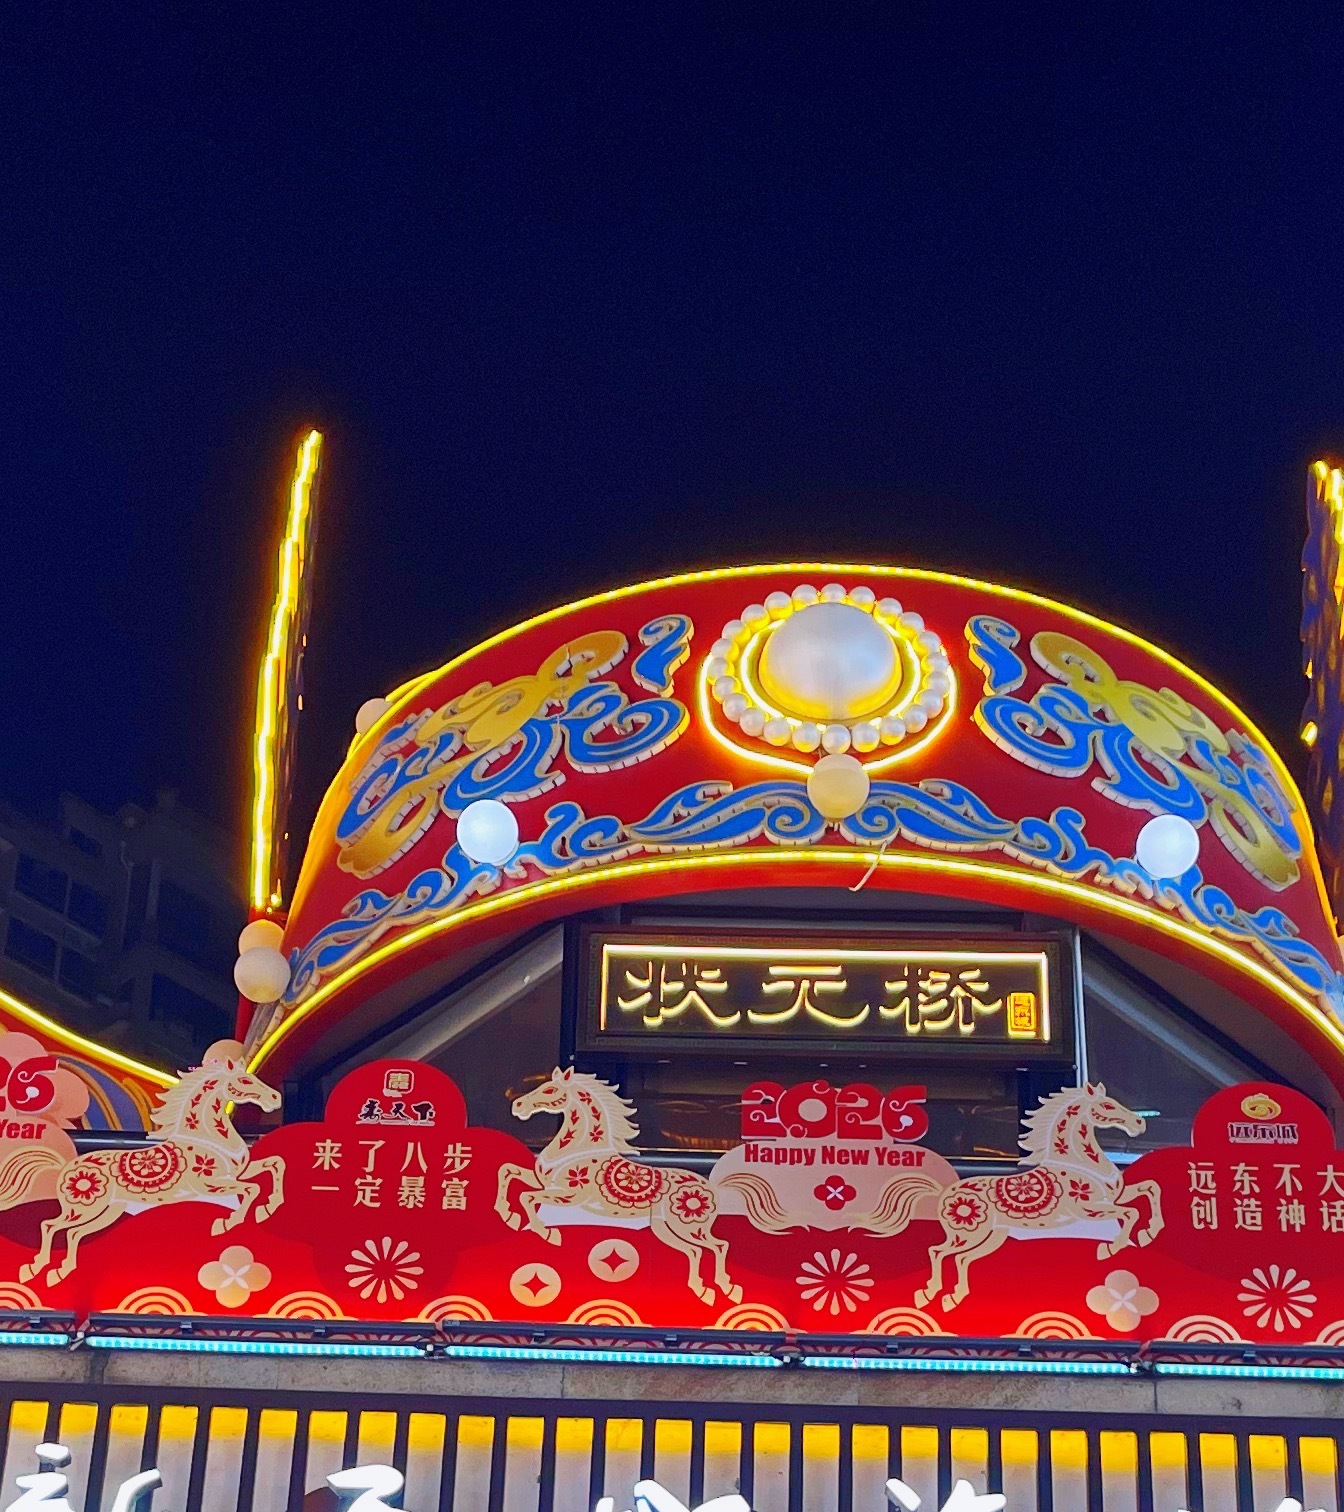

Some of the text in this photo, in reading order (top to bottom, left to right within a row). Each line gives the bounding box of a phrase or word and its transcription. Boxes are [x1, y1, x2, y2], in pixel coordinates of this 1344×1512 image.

[741, 1079, 929, 1143] 2026
[312, 1138, 473, 1175] 来了八步
[743, 1142, 927, 1168] Happy New Year
[311, 1175, 470, 1211] 一定暴富
